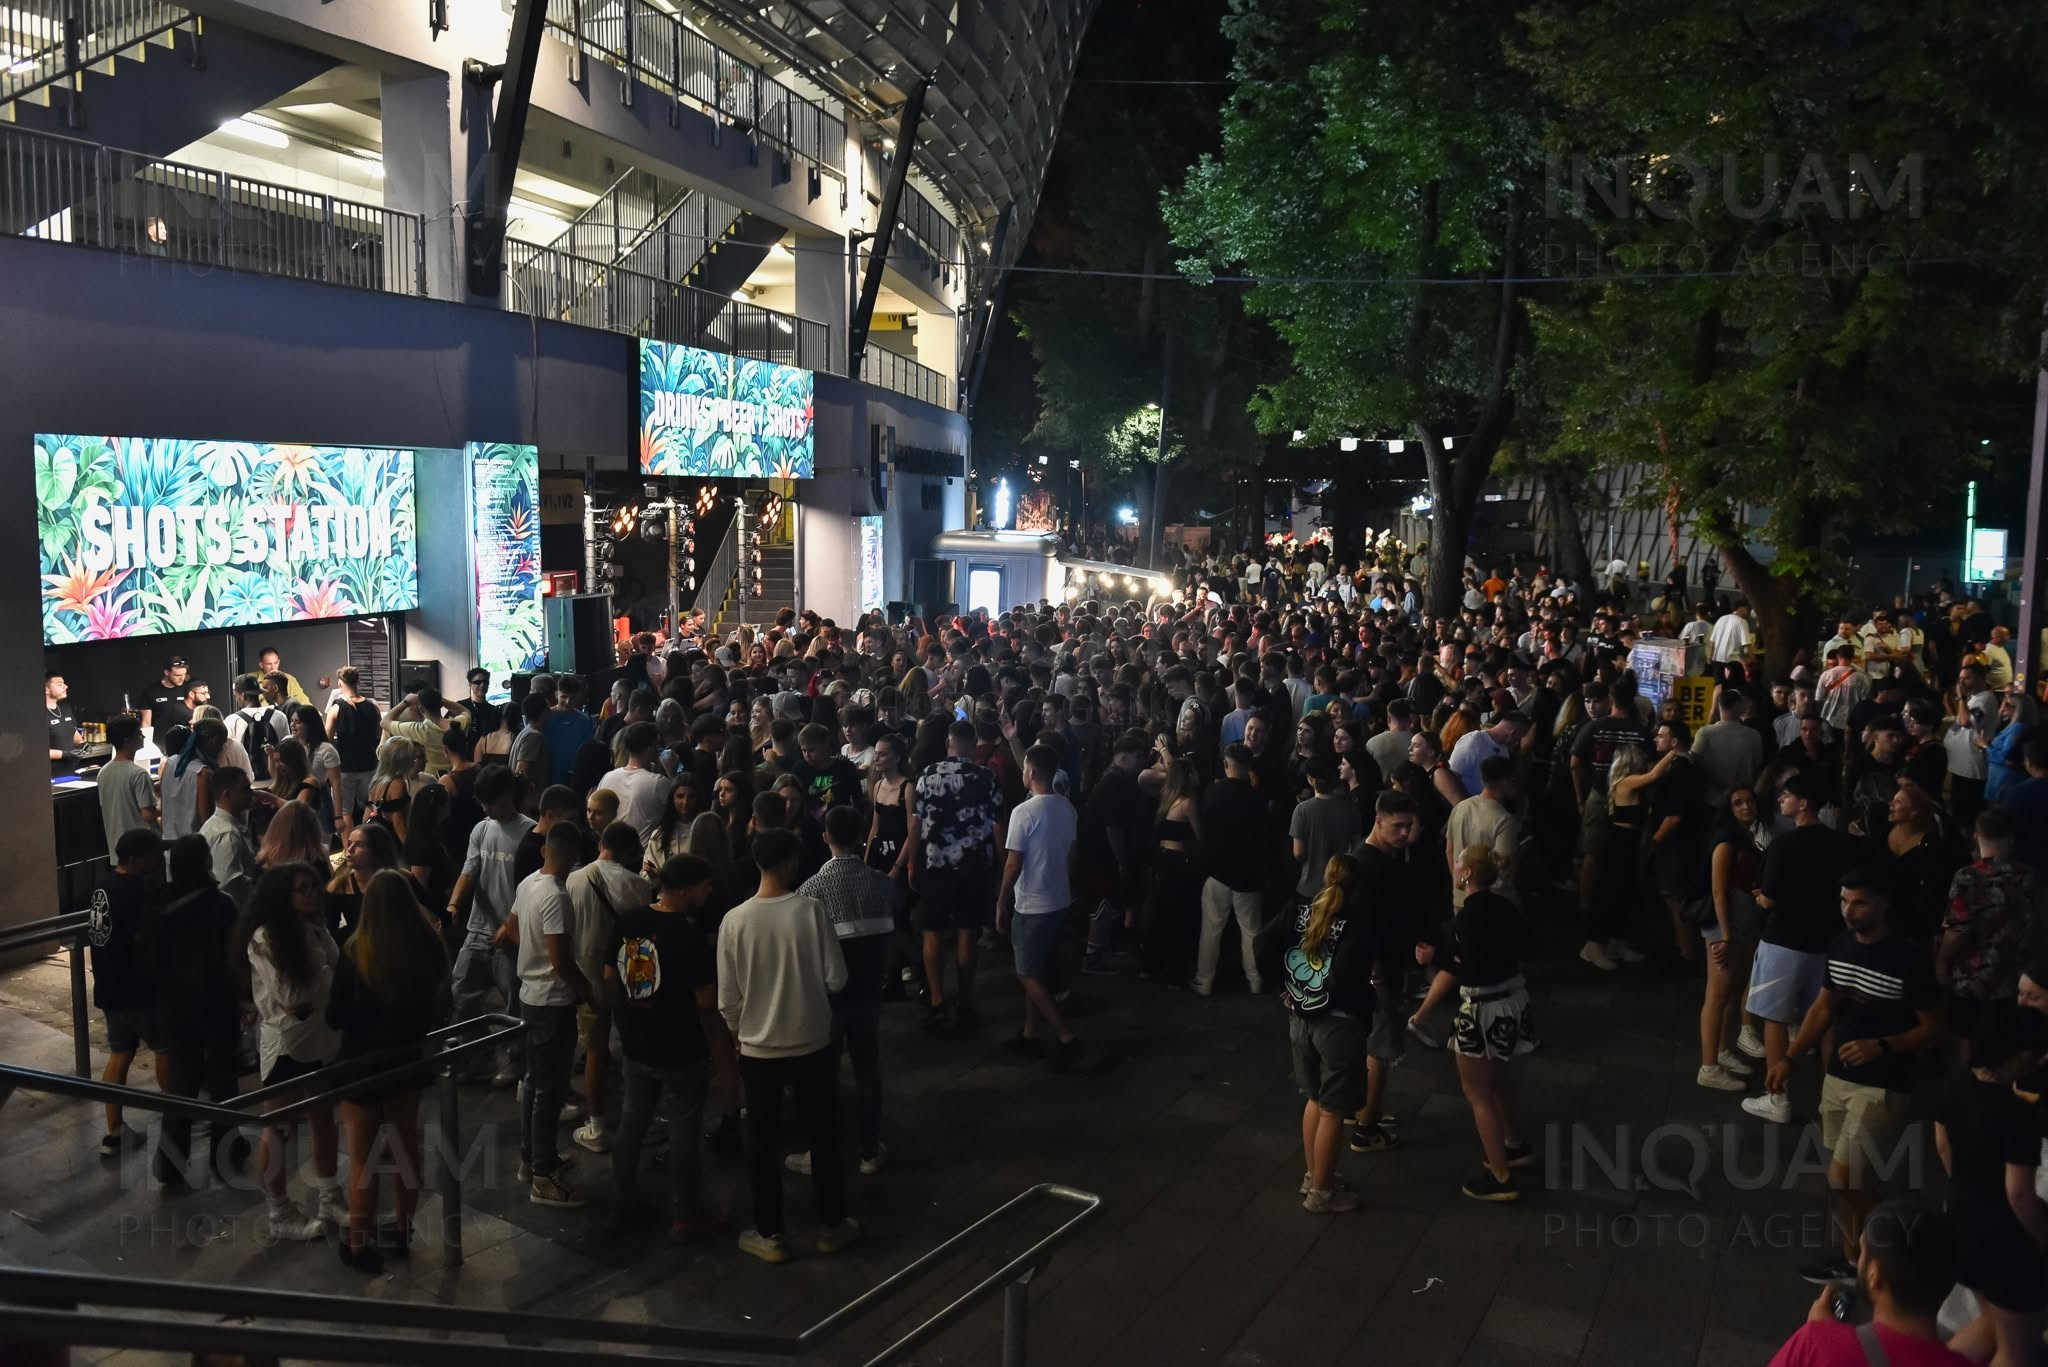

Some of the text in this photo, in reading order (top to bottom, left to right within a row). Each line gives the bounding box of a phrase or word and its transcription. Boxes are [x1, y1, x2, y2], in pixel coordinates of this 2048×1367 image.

[654, 390, 710, 431] DRINKS
[720, 398, 756, 434] BEER
[767, 403, 806, 439] SHOTS
[82, 503, 391, 572] SHOTS STATION
[1681, 686, 1705, 702] BE
